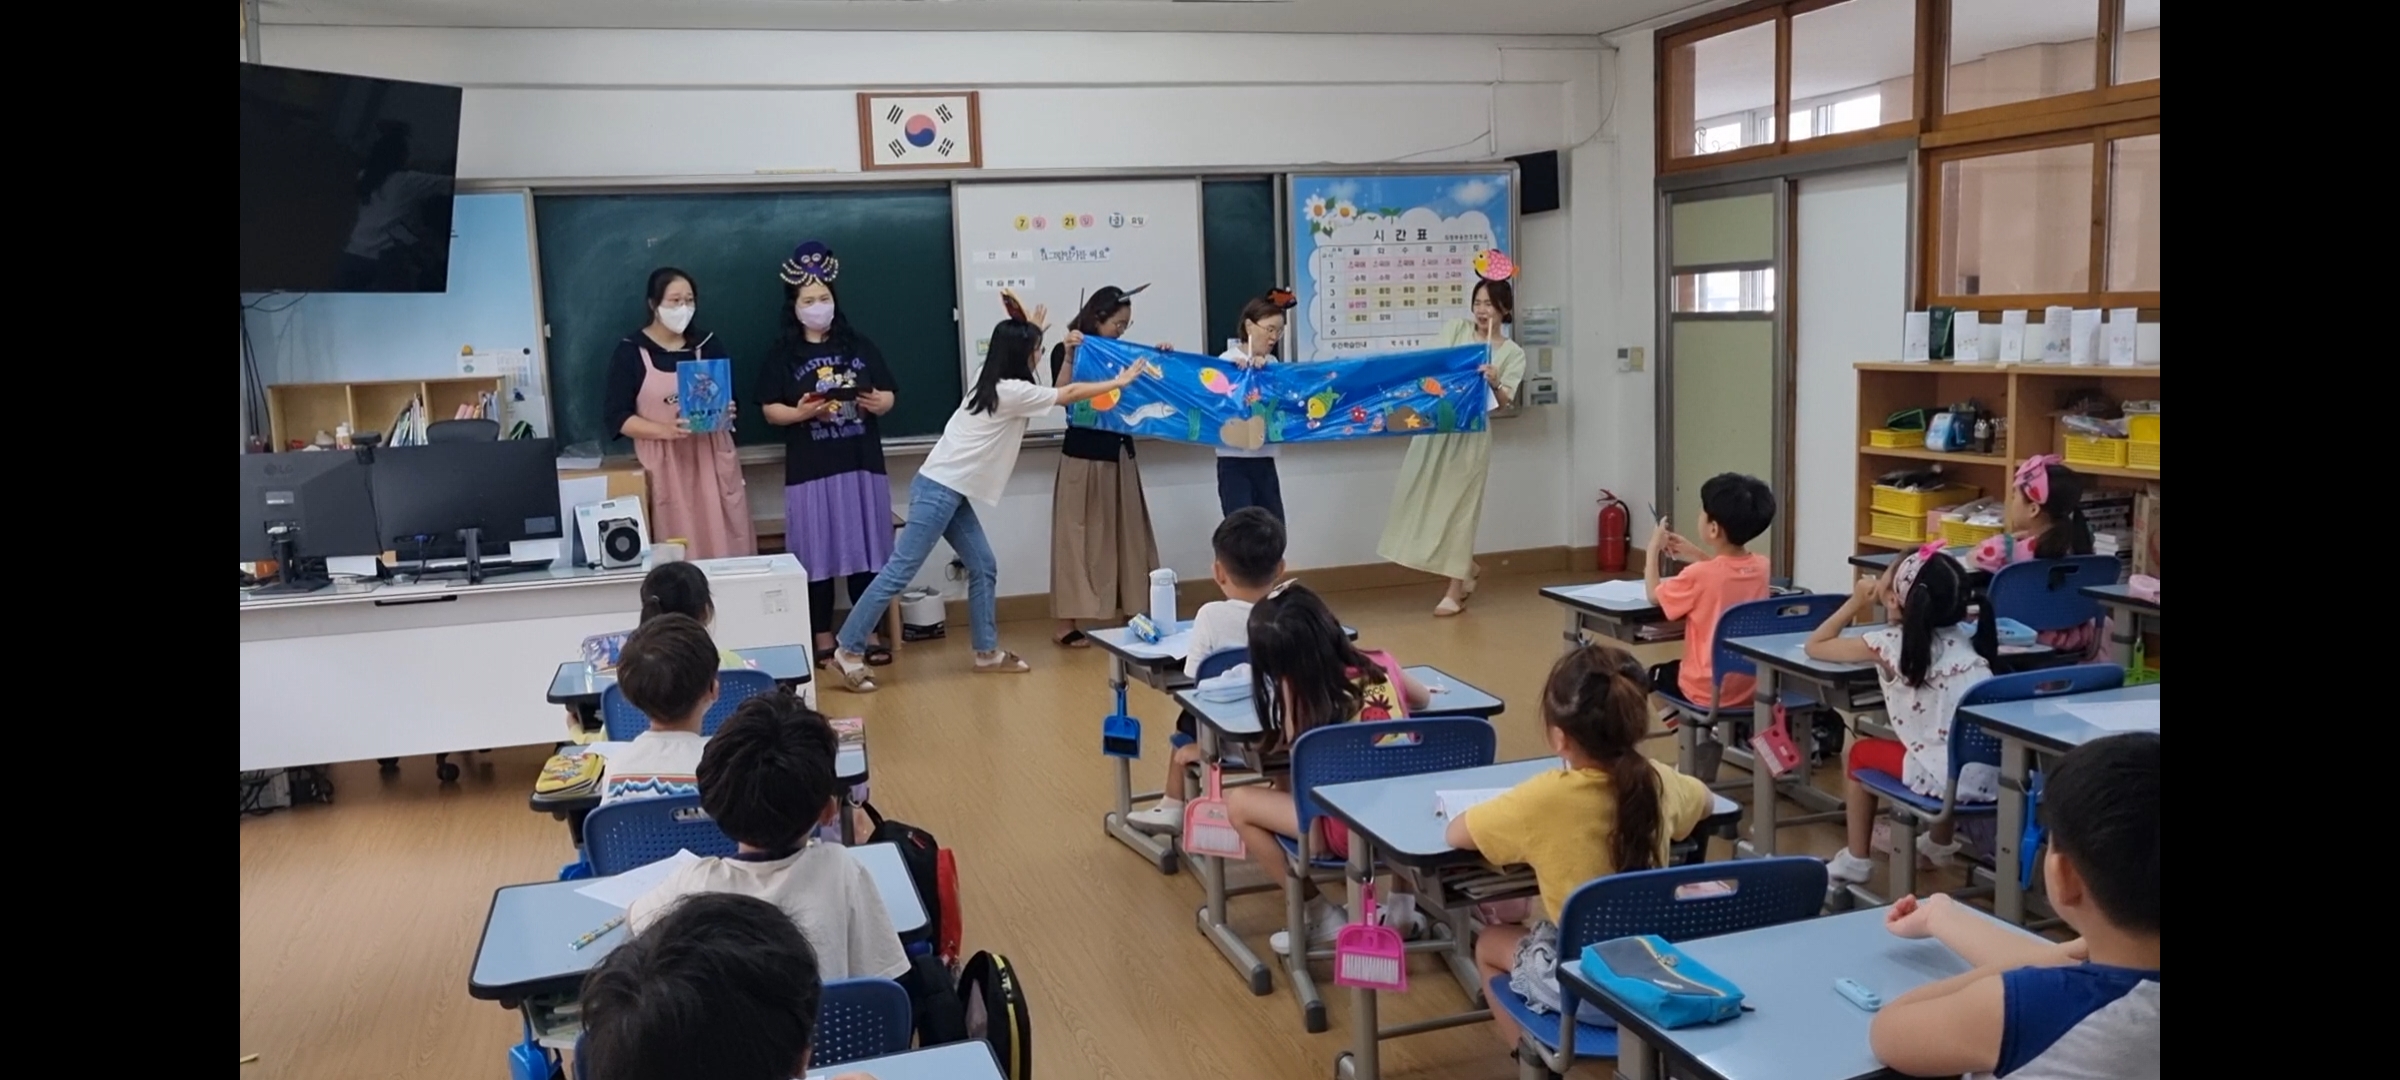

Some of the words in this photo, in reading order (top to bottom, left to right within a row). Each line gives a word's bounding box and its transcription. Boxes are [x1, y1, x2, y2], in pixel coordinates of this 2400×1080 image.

[1019, 219, 1026, 228] 7
[1064, 217, 1075, 226] 21
[1130, 216, 1144, 225] 요일
[1402, 246, 1409, 254] 수
[1425, 245, 1433, 253] 목
[1449, 244, 1457, 253] 금
[1329, 275, 1336, 283] 2
[1329, 288, 1336, 297] 3
[1329, 302, 1336, 310] 4
[1330, 315, 1337, 323] 5
[1330, 328, 1337, 336] 6
